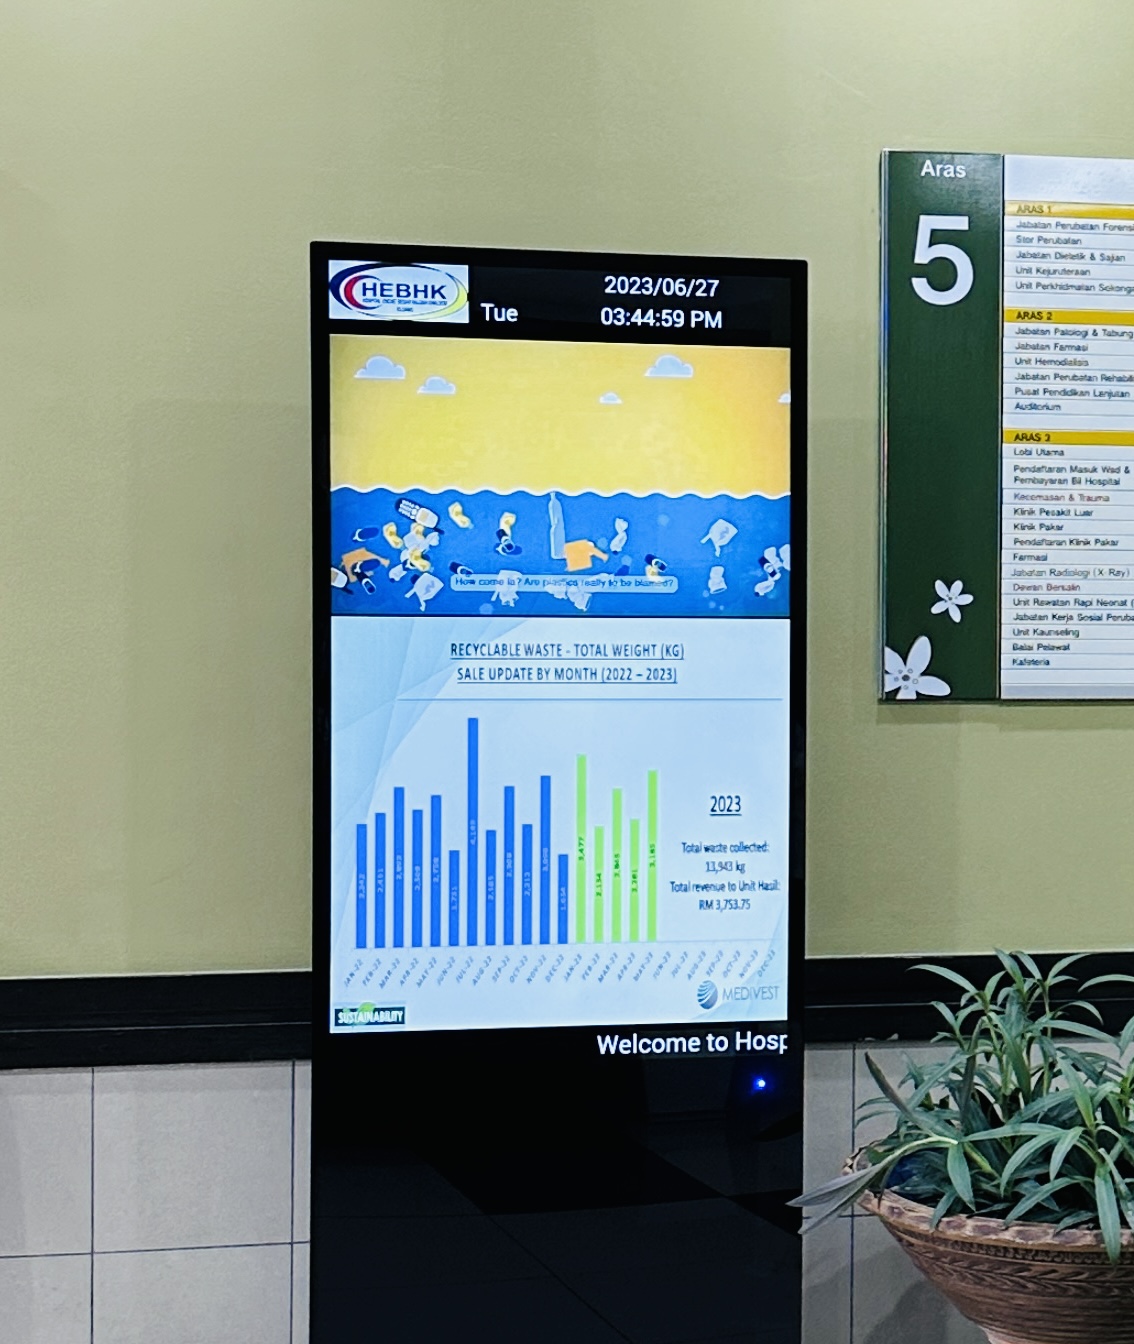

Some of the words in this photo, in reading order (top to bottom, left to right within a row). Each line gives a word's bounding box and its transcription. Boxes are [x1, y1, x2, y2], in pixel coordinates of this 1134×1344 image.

[920, 159, 966, 179] Aras
[1016, 205, 1044, 214] ARAS
[910, 214, 975, 306] 5
[362, 282, 447, 300] HEBHK
[604, 275, 720, 298] 2023/06/27
[480, 302, 519, 322] Tue
[600, 307, 685, 327] 03:44:59
[690, 310, 722, 329] PM
[1015, 311, 1043, 320] ARAS
[1014, 433, 1042, 442] ARAS
[451, 643, 521, 657] RECYCLABLE
[524, 643, 562, 657] WASTE
[574, 643, 609, 657] TOTAL
[612, 643, 657, 658] WEIGHT
[661, 643, 684, 660] (KG)
[457, 667, 485, 681] SALE
[489, 667, 532, 681] UPDATE
[537, 667, 550, 681] BY
[555, 667, 598, 681] MONTH
[601, 667, 632, 683] (2022
[646, 667, 678, 683] 2023)
[710, 795, 742, 813] 2023
[681, 841, 702, 853] Total
[703, 843, 727, 853] waste
[736, 860, 746, 874] kg
[670, 880, 690, 893] Total
[692, 882, 726, 892] revenue
[728, 881, 737, 892] to
[699, 899, 714, 910] RM
[722, 985, 781, 1002] MEDIVEST
[338, 1009, 404, 1025] SUSTAINABILITY
[597, 1033, 701, 1055] Welcome
[706, 1033, 729, 1053] to
